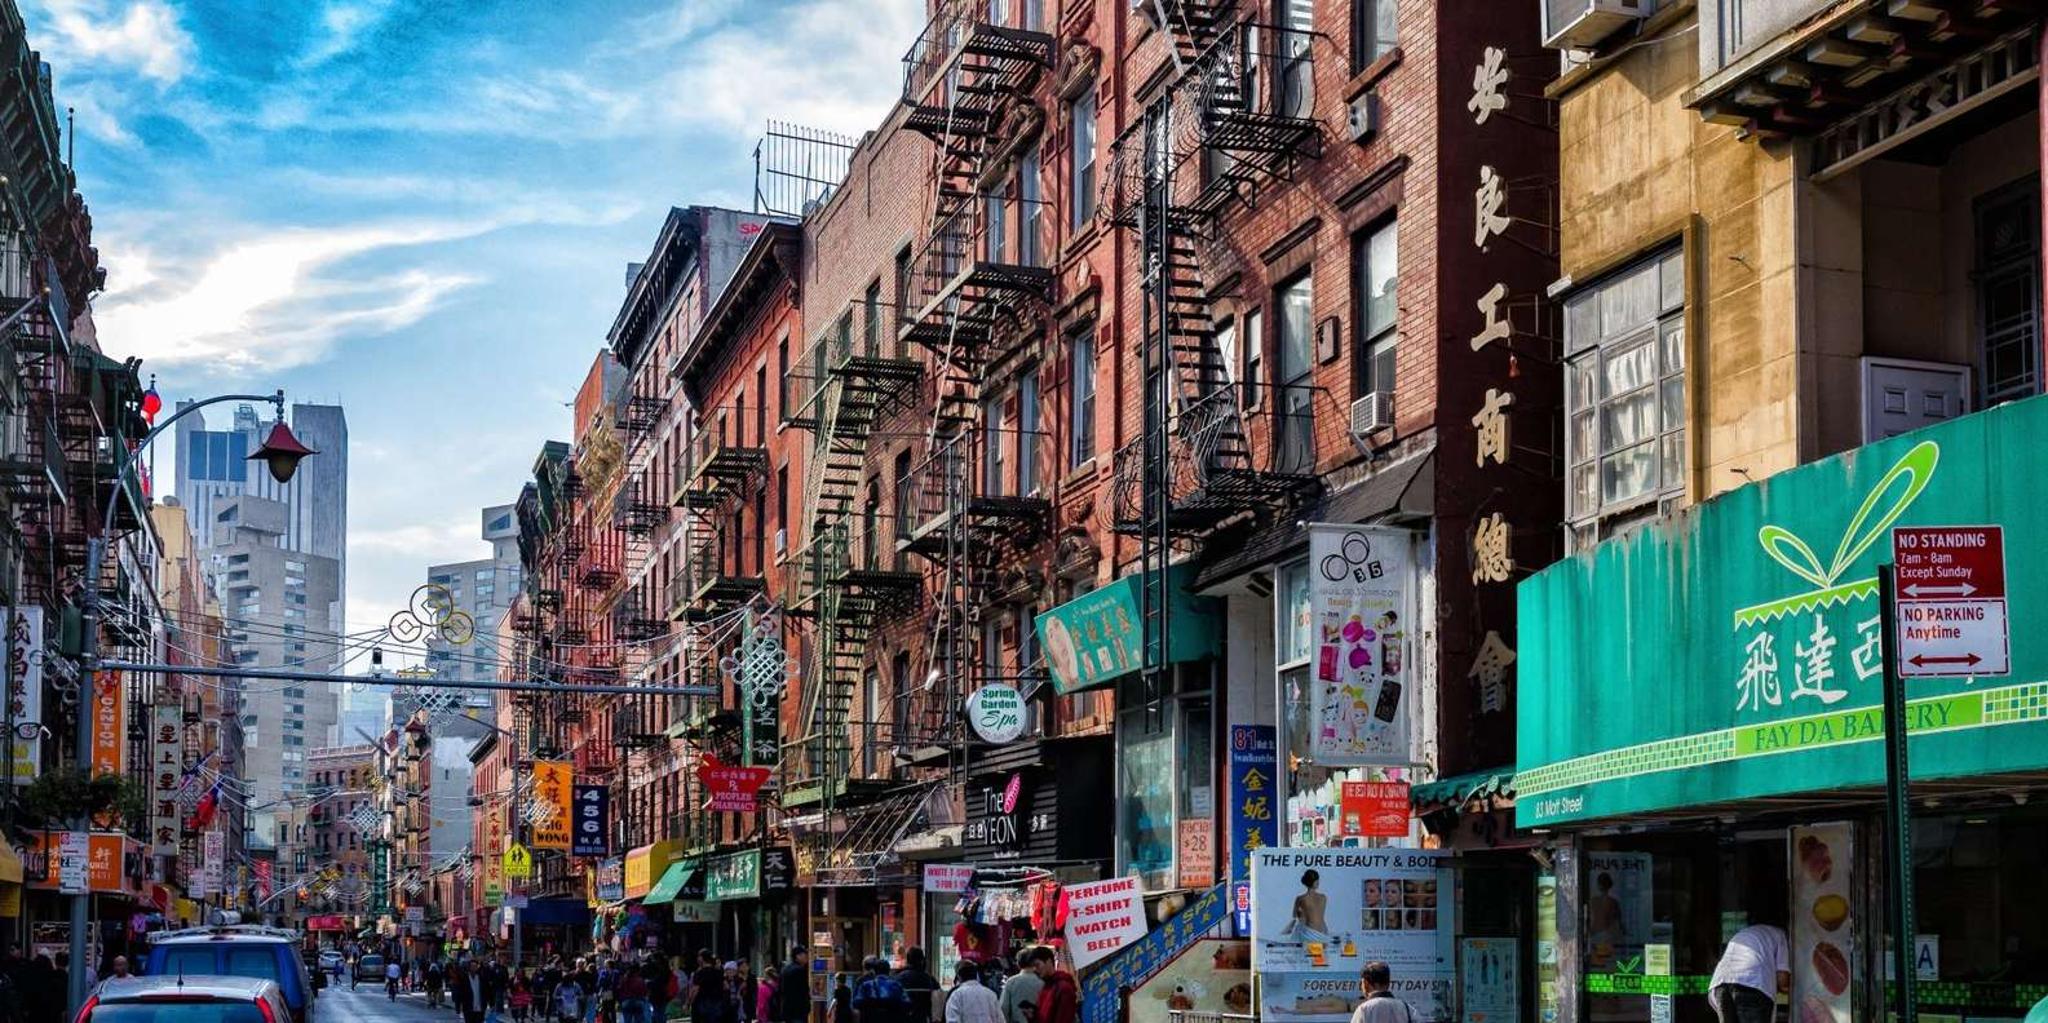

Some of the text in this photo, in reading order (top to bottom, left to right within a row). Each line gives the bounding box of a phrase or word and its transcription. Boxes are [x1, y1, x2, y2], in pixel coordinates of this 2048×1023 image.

[1467, 46, 1515, 713] 安良工商總會
[1898, 533, 1986, 548] NO STANDING
[1900, 552, 1921, 564] 7am
[1931, 552, 1952, 564] 8am
[1900, 566, 1972, 578] Except Sunday
[1904, 607, 1985, 622] NO PARKING
[1906, 625, 1961, 641] Anytime
[982, 689, 1015, 699] Spring
[981, 700, 1018, 709] Garden
[980, 710, 1018, 731] Spa
[1755, 700, 1954, 751] FAY DA BAERY
[1235, 729, 1256, 750] 81
[582, 789, 600, 832] 456
[711, 802, 756, 810] PHARMACY
[983, 786, 1004, 815] The
[1545, 798, 1560, 817] Mott
[1561, 794, 1583, 815] Street
[536, 832, 569, 844] WONG
[982, 814, 1017, 846] YEON
[1184, 835, 1208, 852] $28
[764, 852, 788, 889] 天仁
[1262, 854, 1437, 868] THE PURE BEAUTY & BOD
[1067, 879, 1135, 900] PERFUME
[1071, 898, 1132, 918] T-SHIRT
[1074, 916, 1131, 936] WATCH
[1087, 936, 1122, 952] BELT
[1088, 937, 1157, 992] FACIAL
[1182, 891, 1218, 922] SPA
[1918, 943, 1934, 969] A
[1303, 979, 1357, 992] FOREVER
[1405, 980, 1430, 992] DAY
